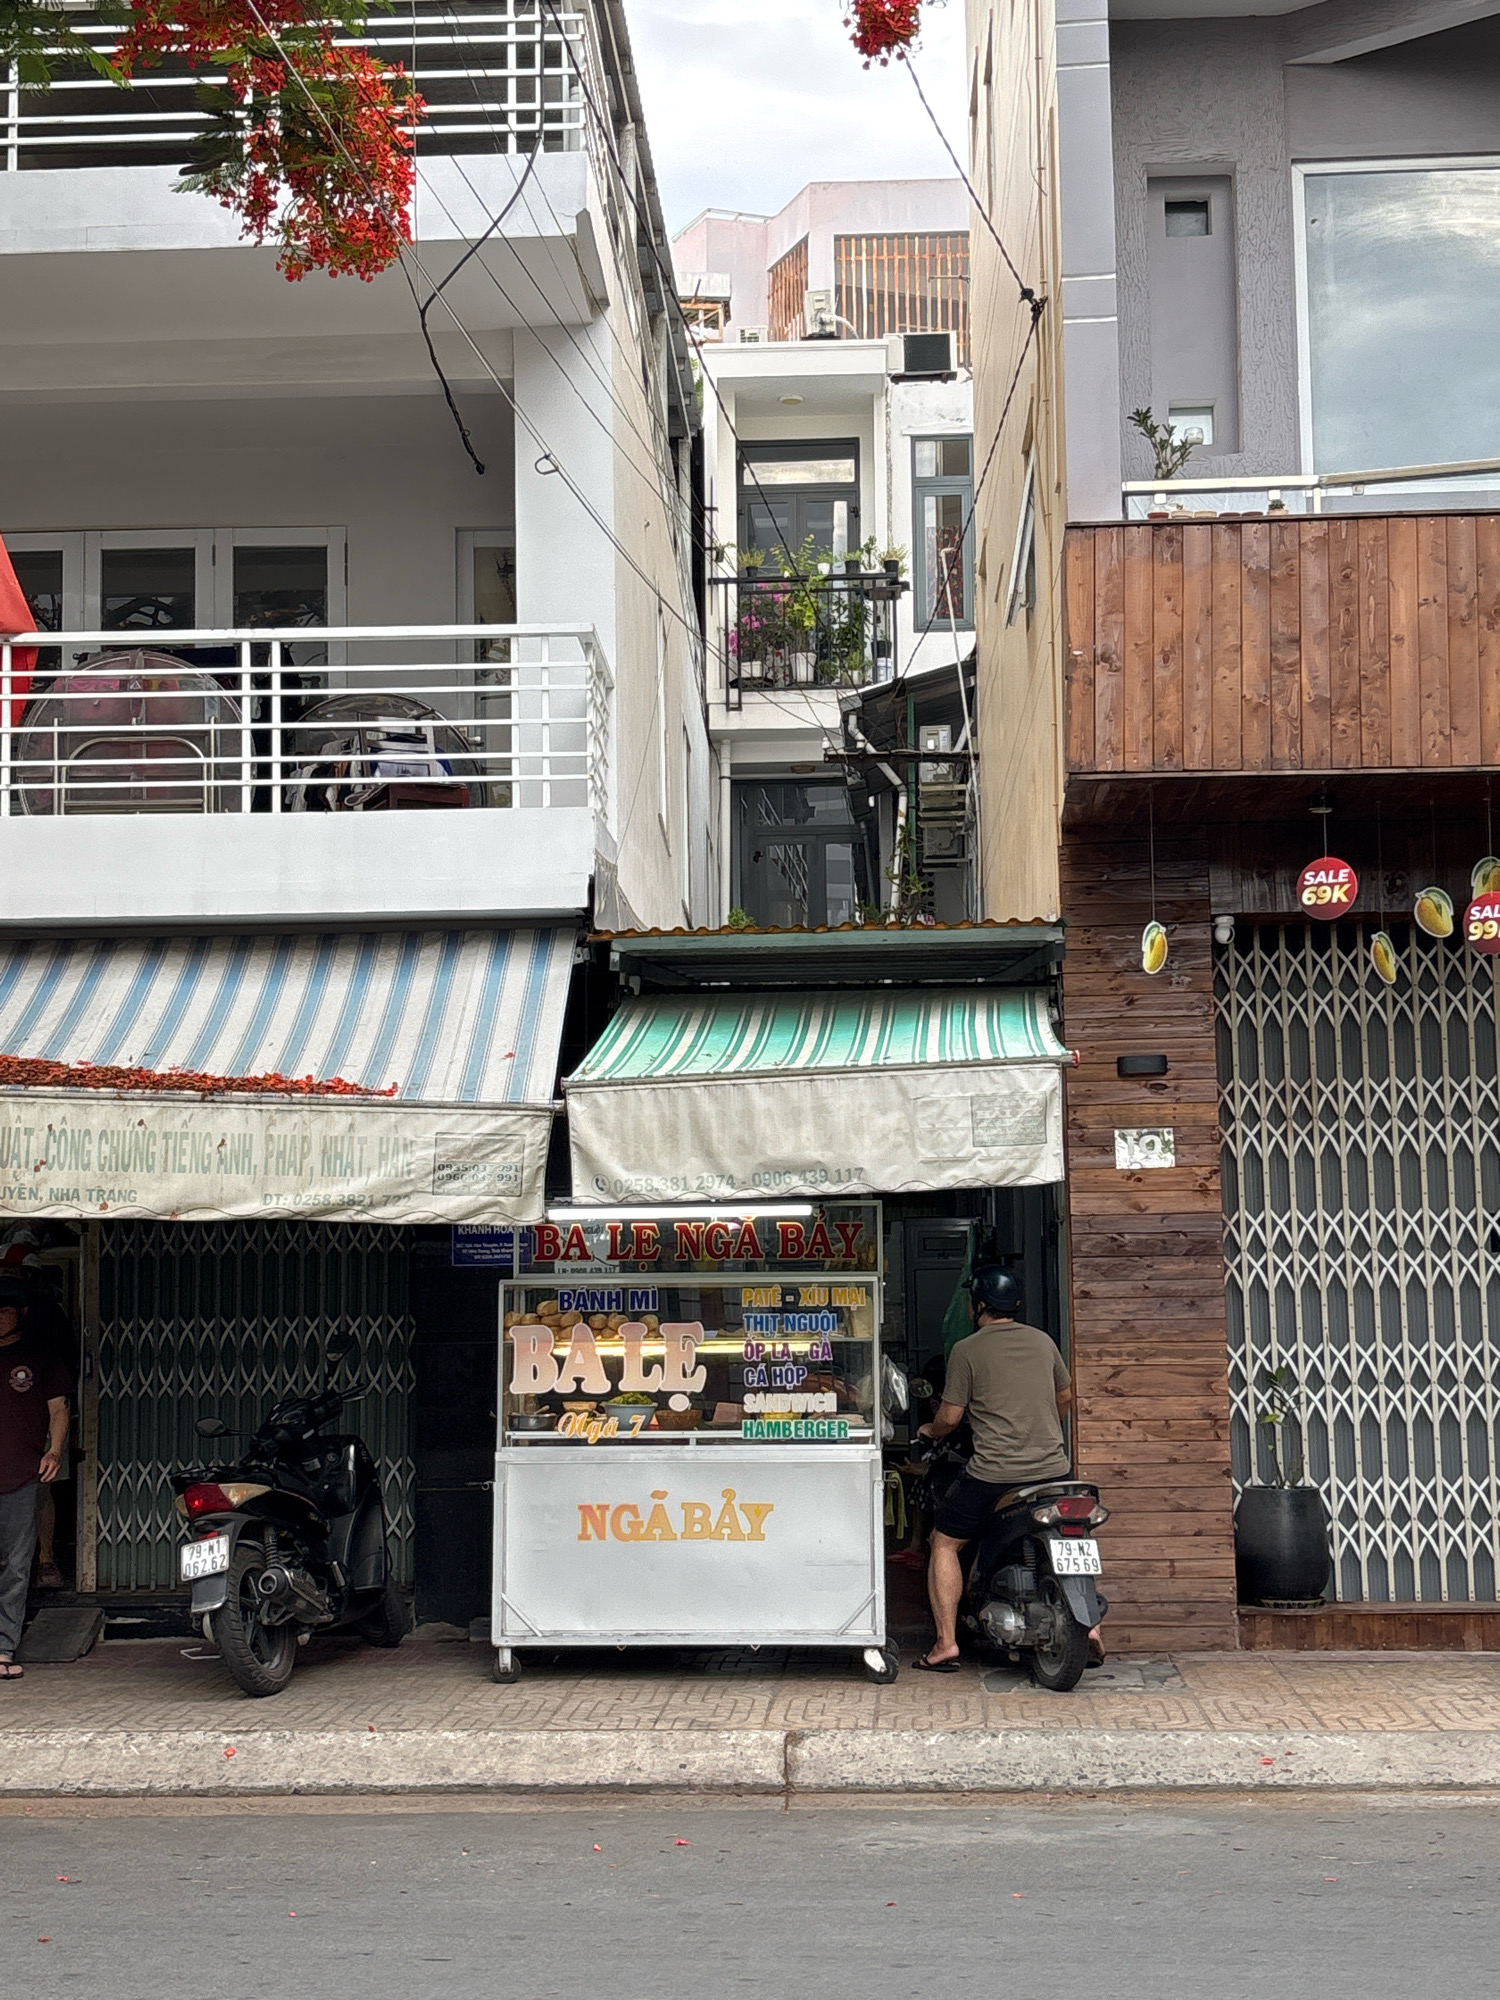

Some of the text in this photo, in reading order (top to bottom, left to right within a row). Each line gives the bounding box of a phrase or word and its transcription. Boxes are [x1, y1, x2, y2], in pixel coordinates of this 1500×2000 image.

[1303, 868, 1351, 886] SALE
[1302, 883, 1352, 906] 69K
[1468, 920, 1500, 941] 99
[44, 1115, 92, 1173] CÔNG
[161, 1113, 213, 1175] TIẾNG
[49, 1188, 81, 1201] NHA
[86, 1189, 138, 1203] TRANG
[533, 1223, 593, 1262] BA
[605, 1221, 662, 1272] LẸ
[776, 1206, 864, 1262] BẢY
[557, 1285, 659, 1312] BÁNH MÌ
[741, 1284, 782, 1308] PATÊ
[798, 1283, 829, 1307] XÍU
[831, 1286, 866, 1311] MẠI
[743, 1309, 837, 1337] THỊT NGUỘI
[743, 1335, 766, 1361] ỐP
[770, 1342, 793, 1361] LA
[743, 1362, 808, 1390] CÁ HỘP
[558, 1411, 646, 1444] Ngã 7
[742, 1418, 850, 1439] HAMBERGER
[577, 1488, 774, 1542] NGÃ BẢY
[184, 1553, 226, 1576] 062.62
